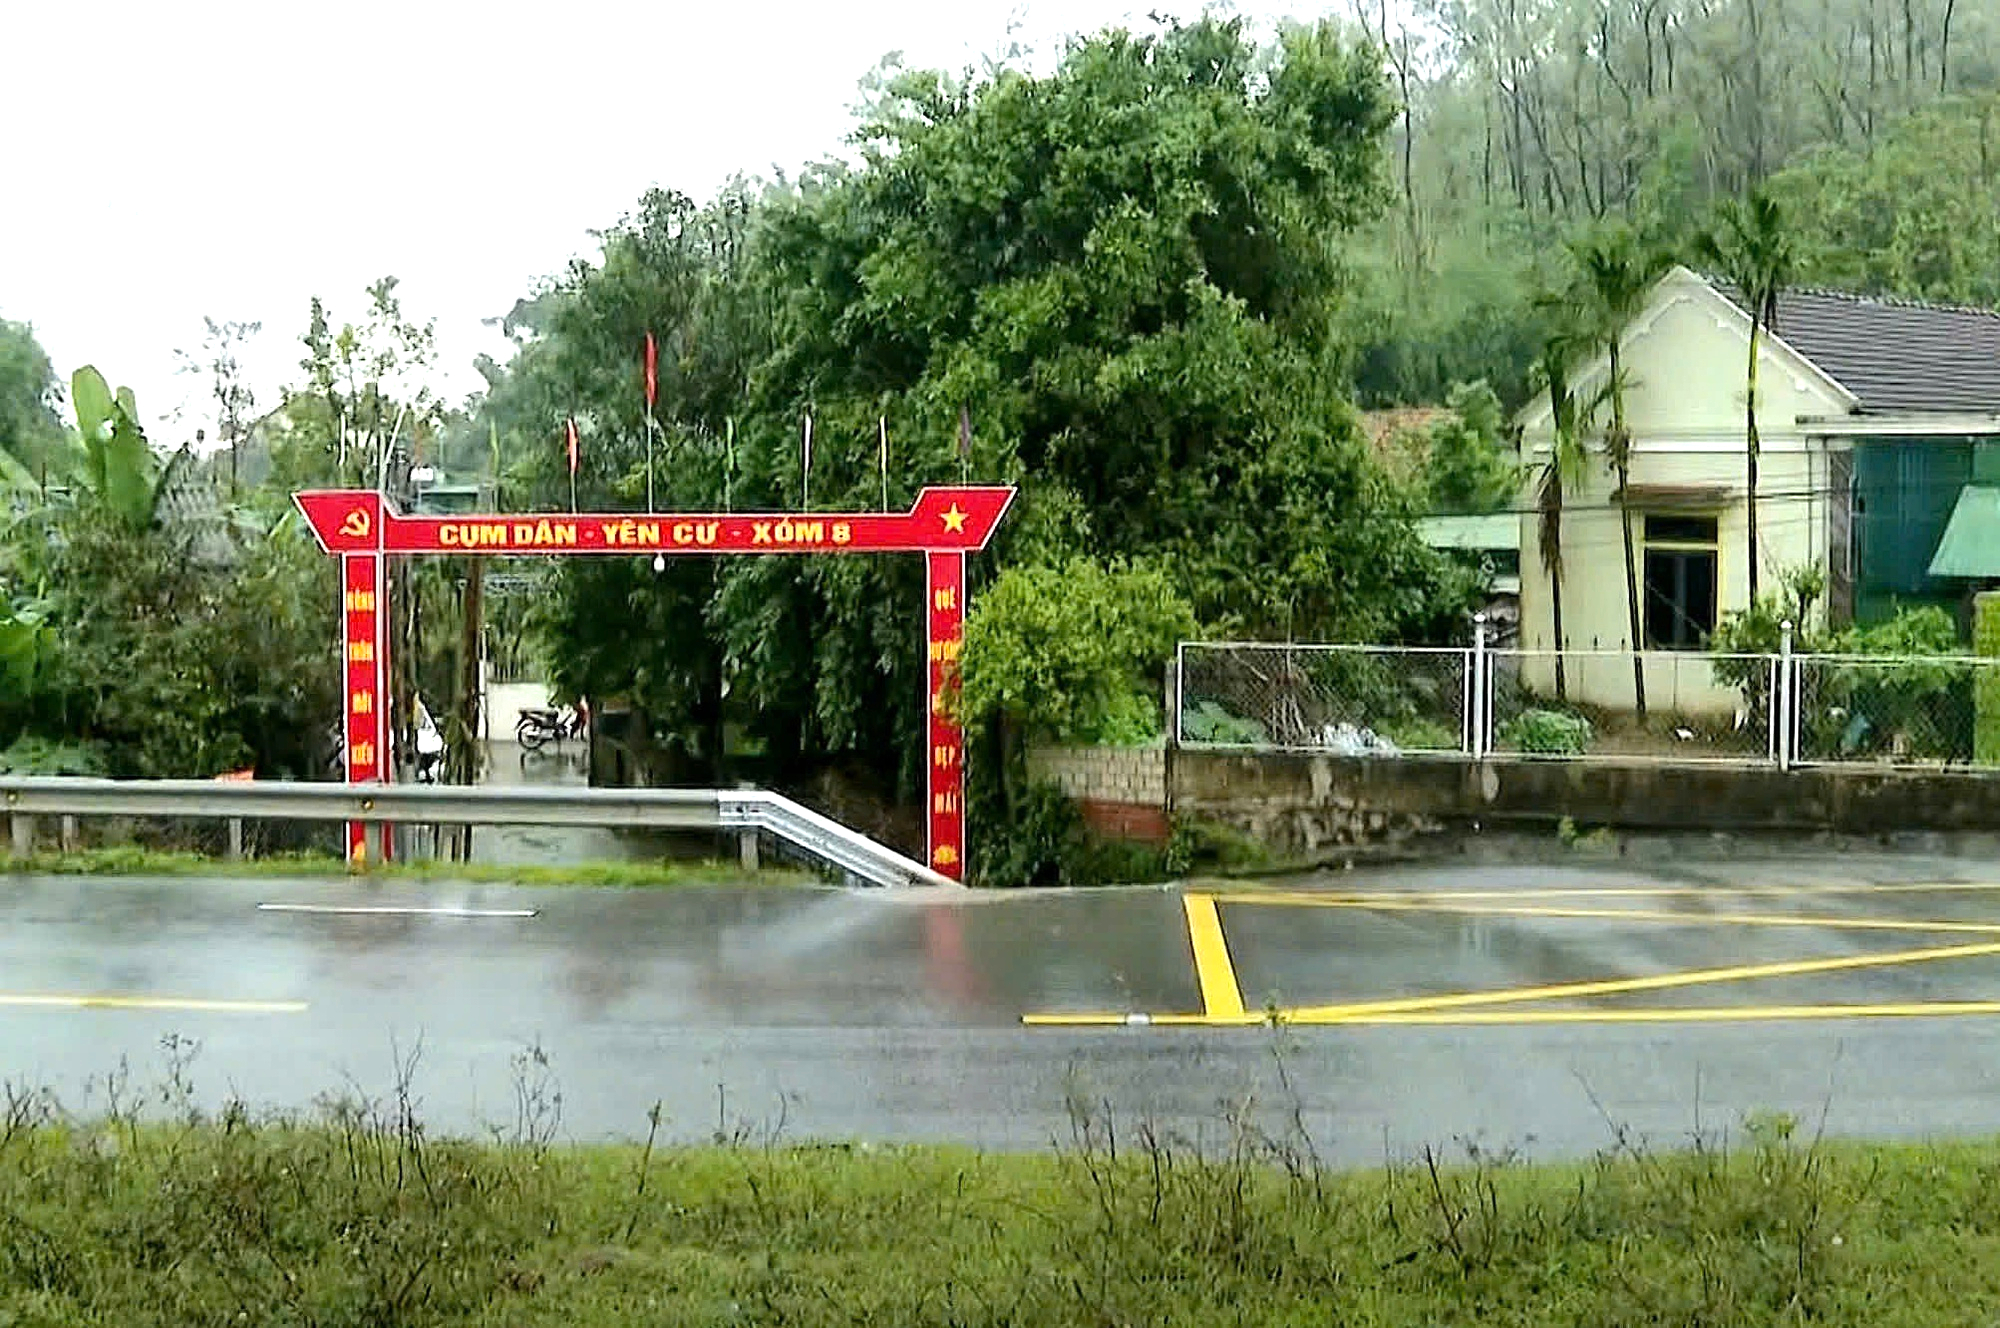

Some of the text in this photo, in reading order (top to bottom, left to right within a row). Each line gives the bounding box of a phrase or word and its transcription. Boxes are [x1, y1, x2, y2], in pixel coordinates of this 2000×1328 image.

[439, 523, 507, 547] CỤM
[513, 519, 577, 545] DÂN
[602, 519, 660, 545] YÊN
[673, 521, 720, 545] CƯ
[752, 517, 824, 545] XÓM
[831, 522, 851, 545] 8
